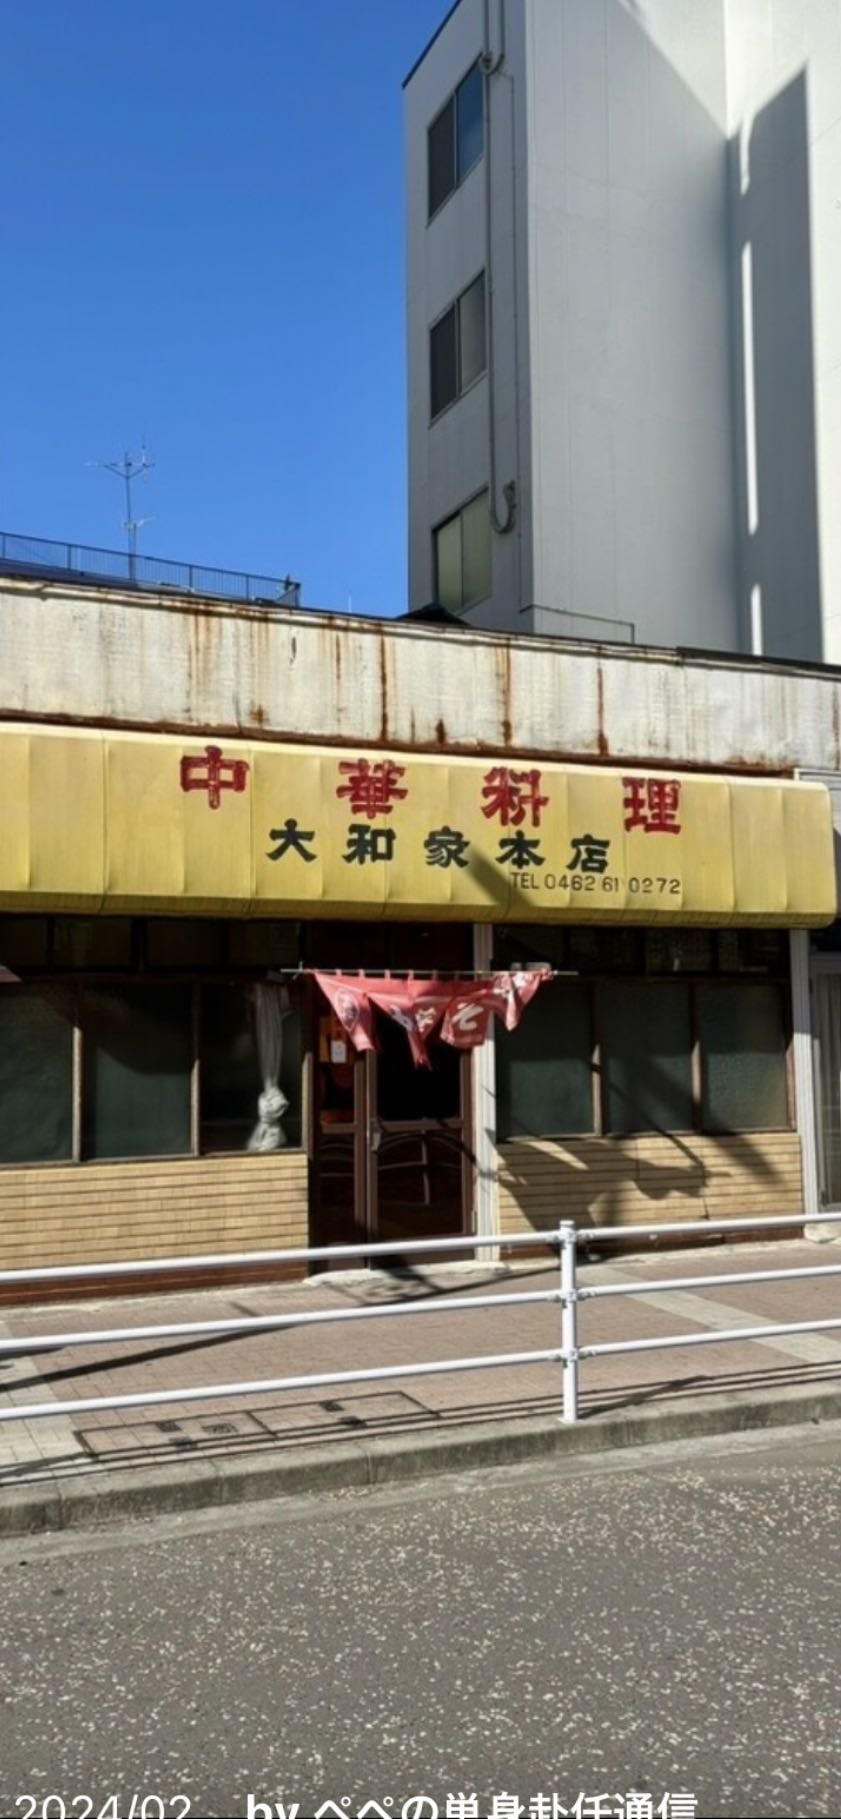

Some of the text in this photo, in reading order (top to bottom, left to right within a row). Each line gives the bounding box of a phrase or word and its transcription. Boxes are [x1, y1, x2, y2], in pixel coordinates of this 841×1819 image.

[180, 745, 683, 835] 中華料理
[266, 818, 611, 874] 大和家本店
[511, 872, 681, 894] TEL 0462 61 0272
